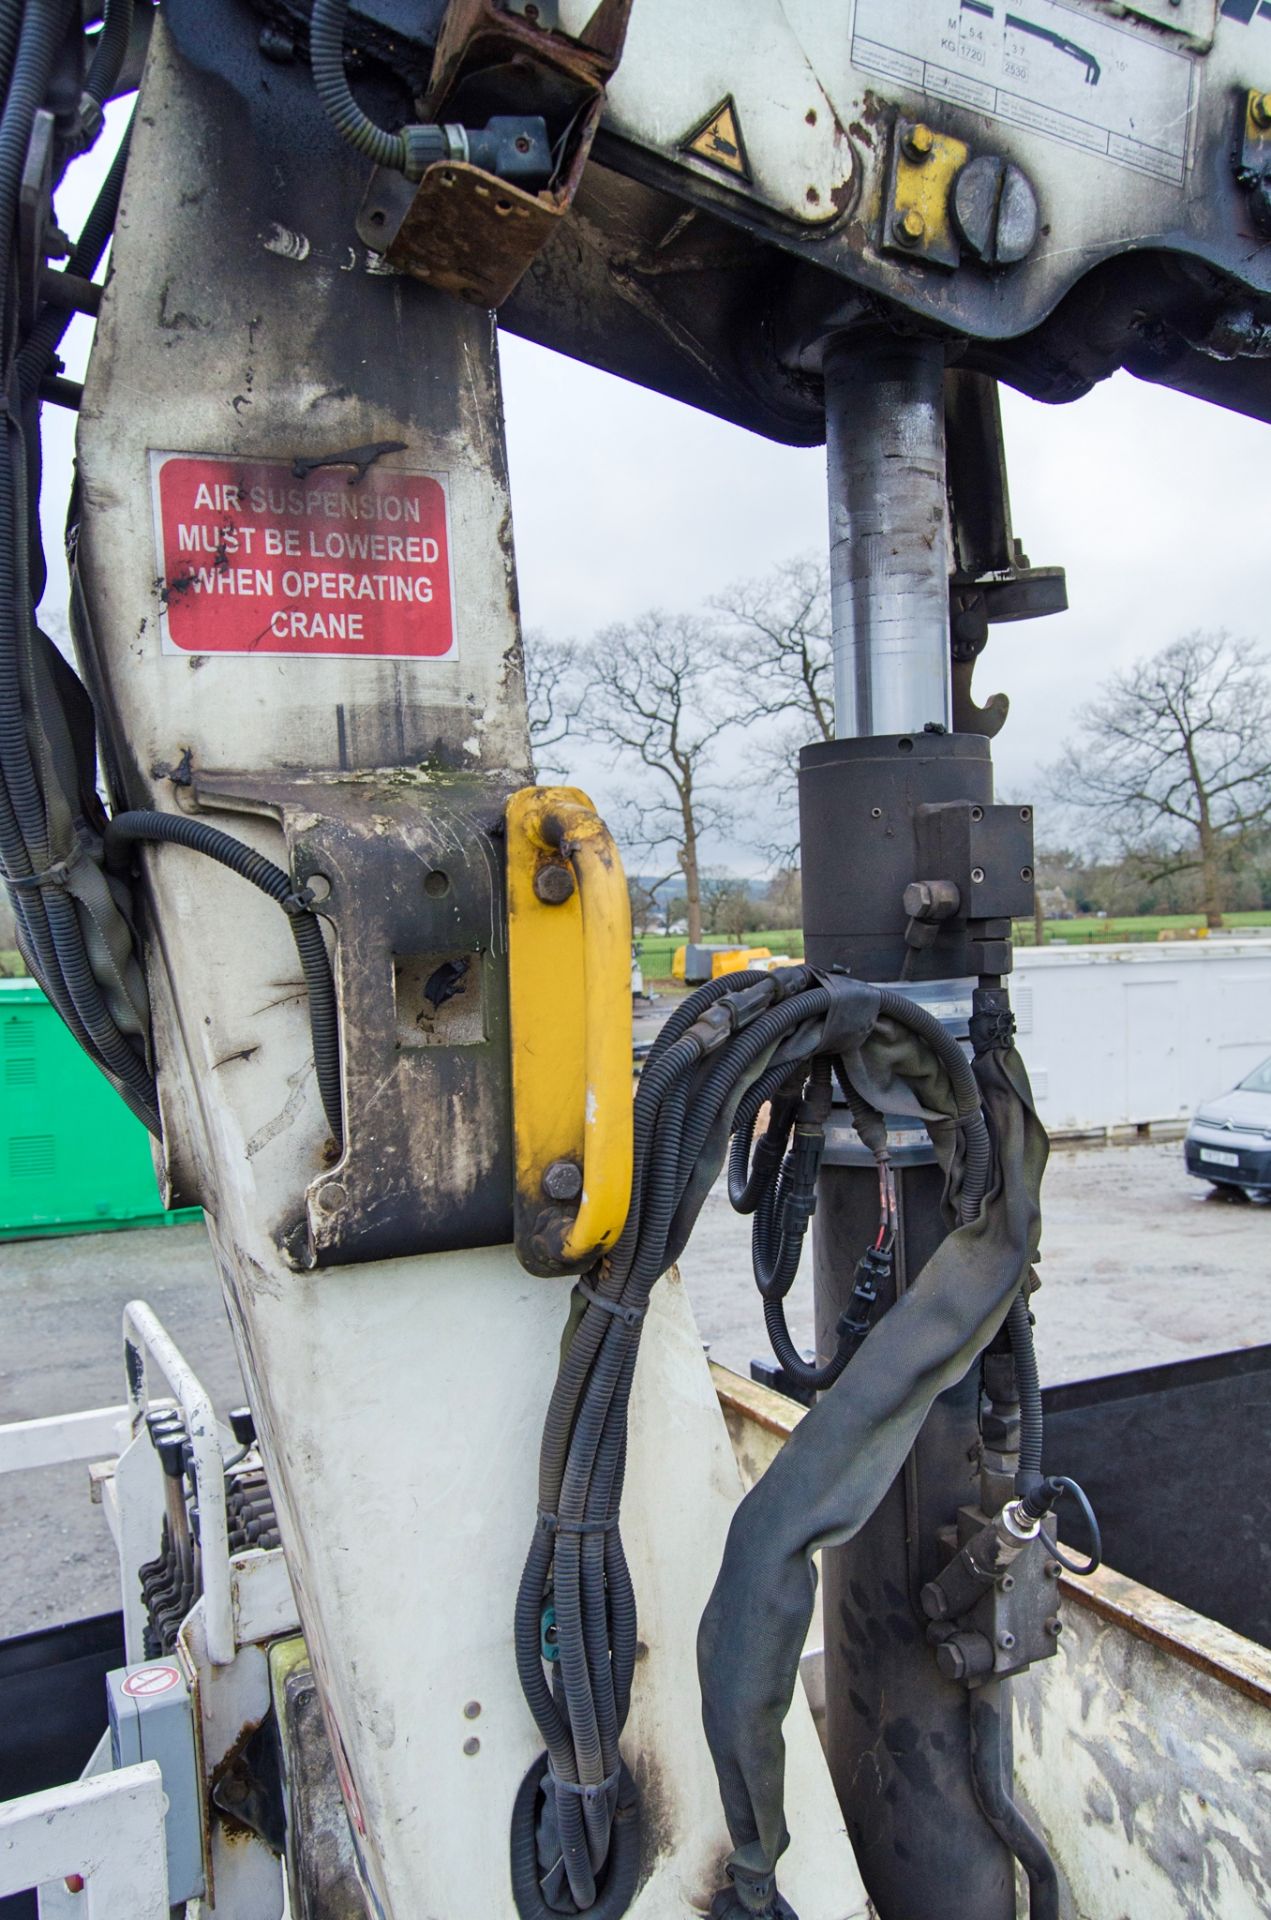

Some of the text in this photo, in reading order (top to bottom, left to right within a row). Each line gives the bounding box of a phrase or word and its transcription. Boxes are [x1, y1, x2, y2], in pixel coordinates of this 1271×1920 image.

[941, 38, 1027, 79] KG 1720 2530
[193, 483, 421, 523] AIR SUSPENSION
[178, 524, 439, 563] MUST BE LOWERED
[188, 566, 434, 603] WHEN OPERATING
[270, 611, 365, 640] CRANE
